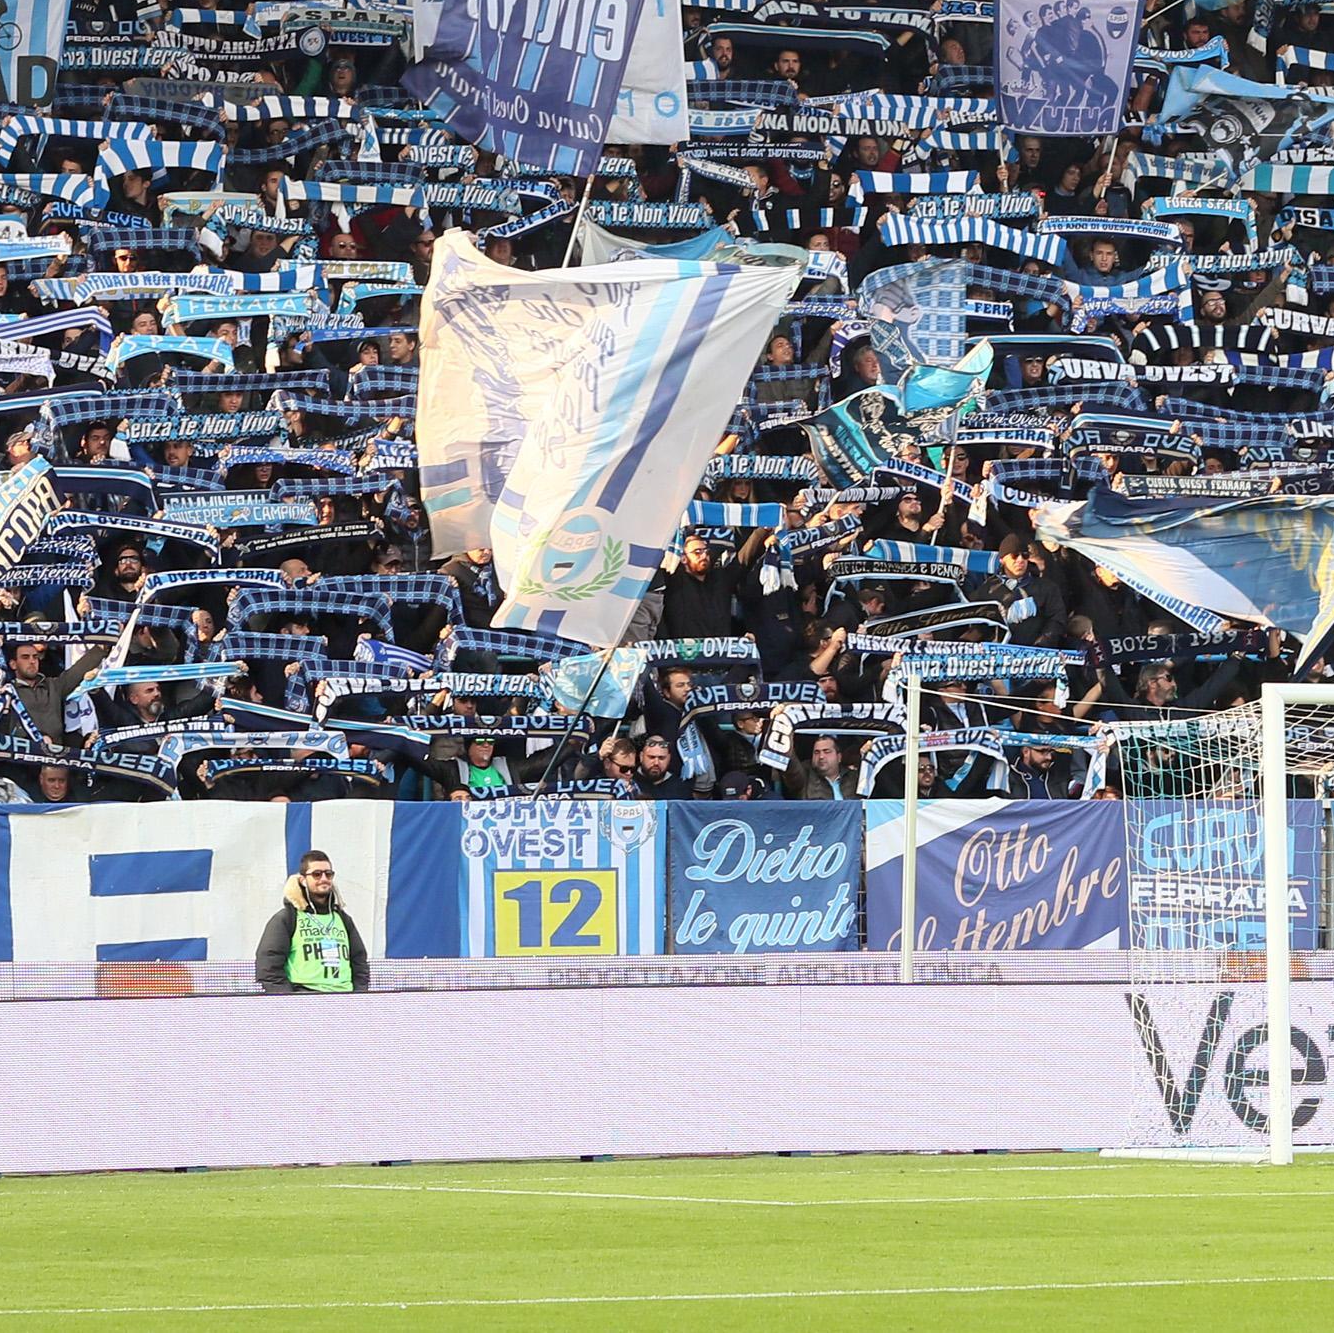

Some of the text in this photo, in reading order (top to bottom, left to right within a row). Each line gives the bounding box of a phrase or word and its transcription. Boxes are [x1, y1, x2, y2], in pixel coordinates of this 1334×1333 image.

[633, 204, 700, 224] Non Vivo
[189, 295, 299, 313] FERRARA
[252, 506, 317, 523] CAMPIONE
[1110, 631, 1238, 654] BOYS 1989
[946, 657, 995, 679] Ovest
[461, 827, 592, 859] OVEST
[685, 818, 848, 883] Dietro
[952, 818, 1053, 907] Otto
[503, 879, 603, 948] 12
[675, 889, 717, 945] le
